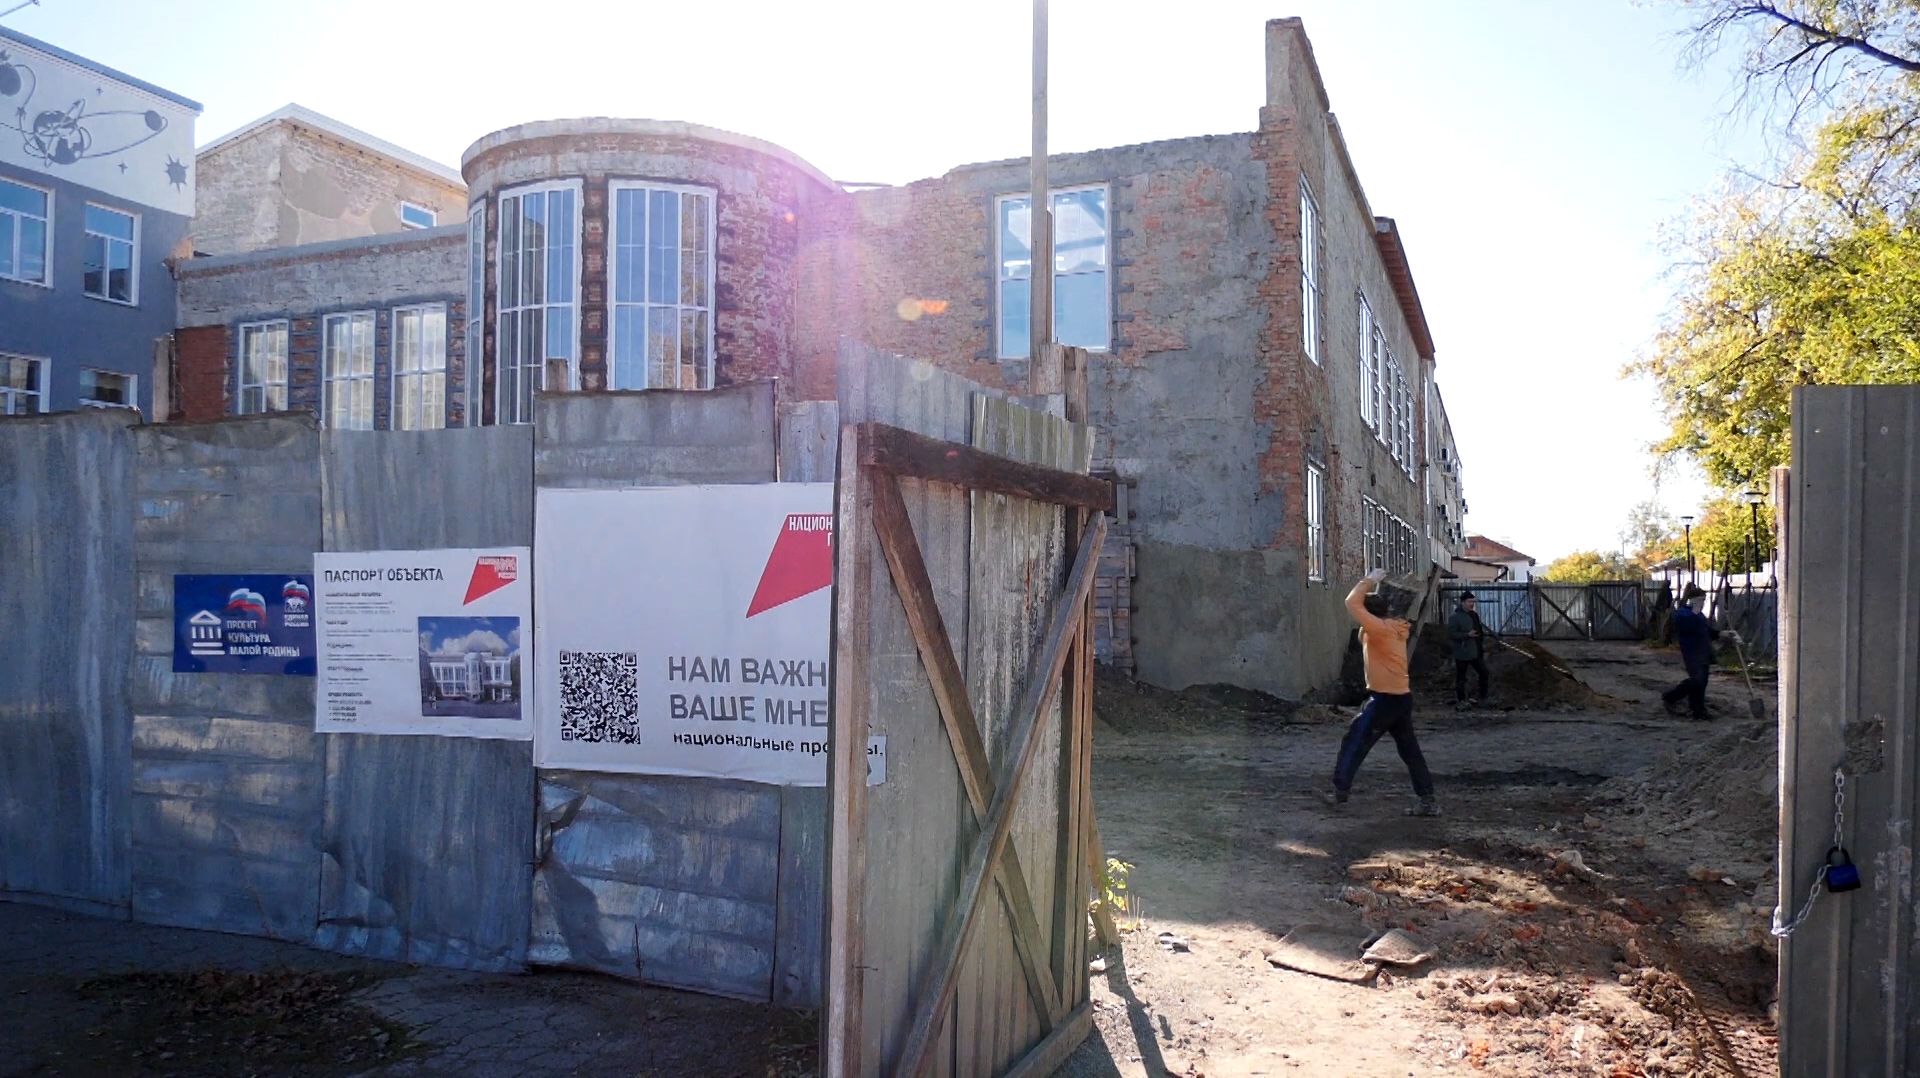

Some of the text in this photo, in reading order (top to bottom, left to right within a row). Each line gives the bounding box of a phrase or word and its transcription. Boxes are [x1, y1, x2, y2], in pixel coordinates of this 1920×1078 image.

[789, 516, 833, 533] НАЦИОН
[324, 567, 444, 583] ПАСПОРТ ОБЪЕКТА
[227, 633, 271, 643] КУЛЬТУРА
[229, 645, 300, 657] МАЛОЙ РОДИНЫ
[668, 656, 828, 687] НАМ ВАЖН
[669, 694, 828, 727] ВАШЕ МНЕ
[673, 731, 795, 752] национальные
